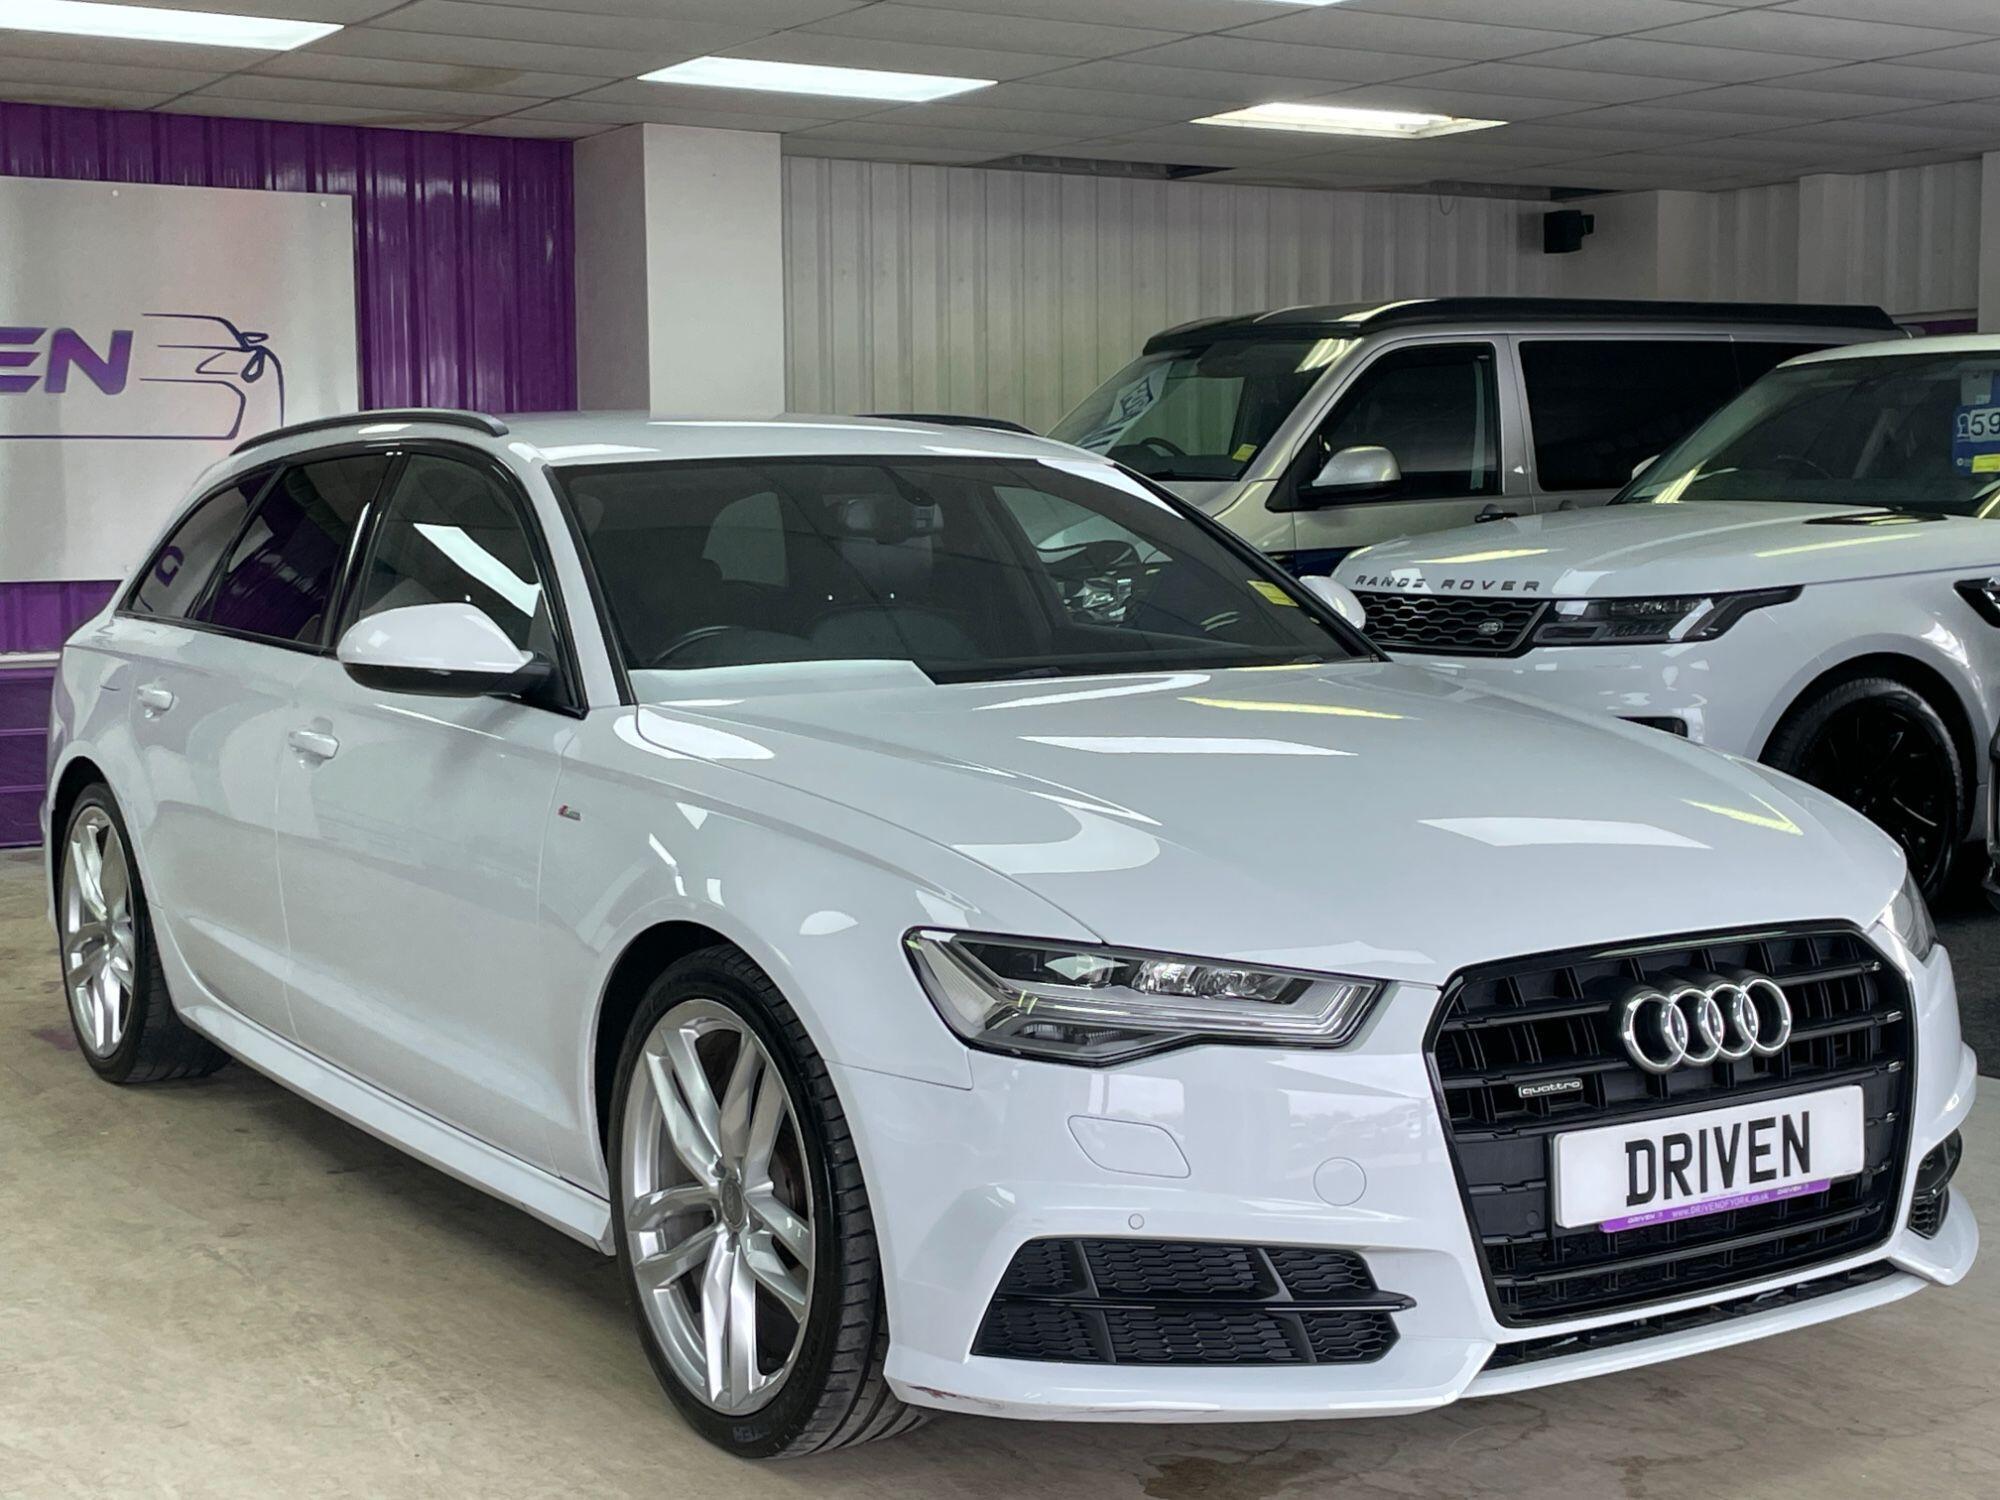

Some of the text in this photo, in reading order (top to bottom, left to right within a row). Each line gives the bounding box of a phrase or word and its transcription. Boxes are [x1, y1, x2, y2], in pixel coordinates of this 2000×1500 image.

[1355, 575, 1540, 592] RANGE ROVER
[1522, 1081, 1581, 1097] quattro
[1625, 1111, 1810, 1207] DRIVEN
